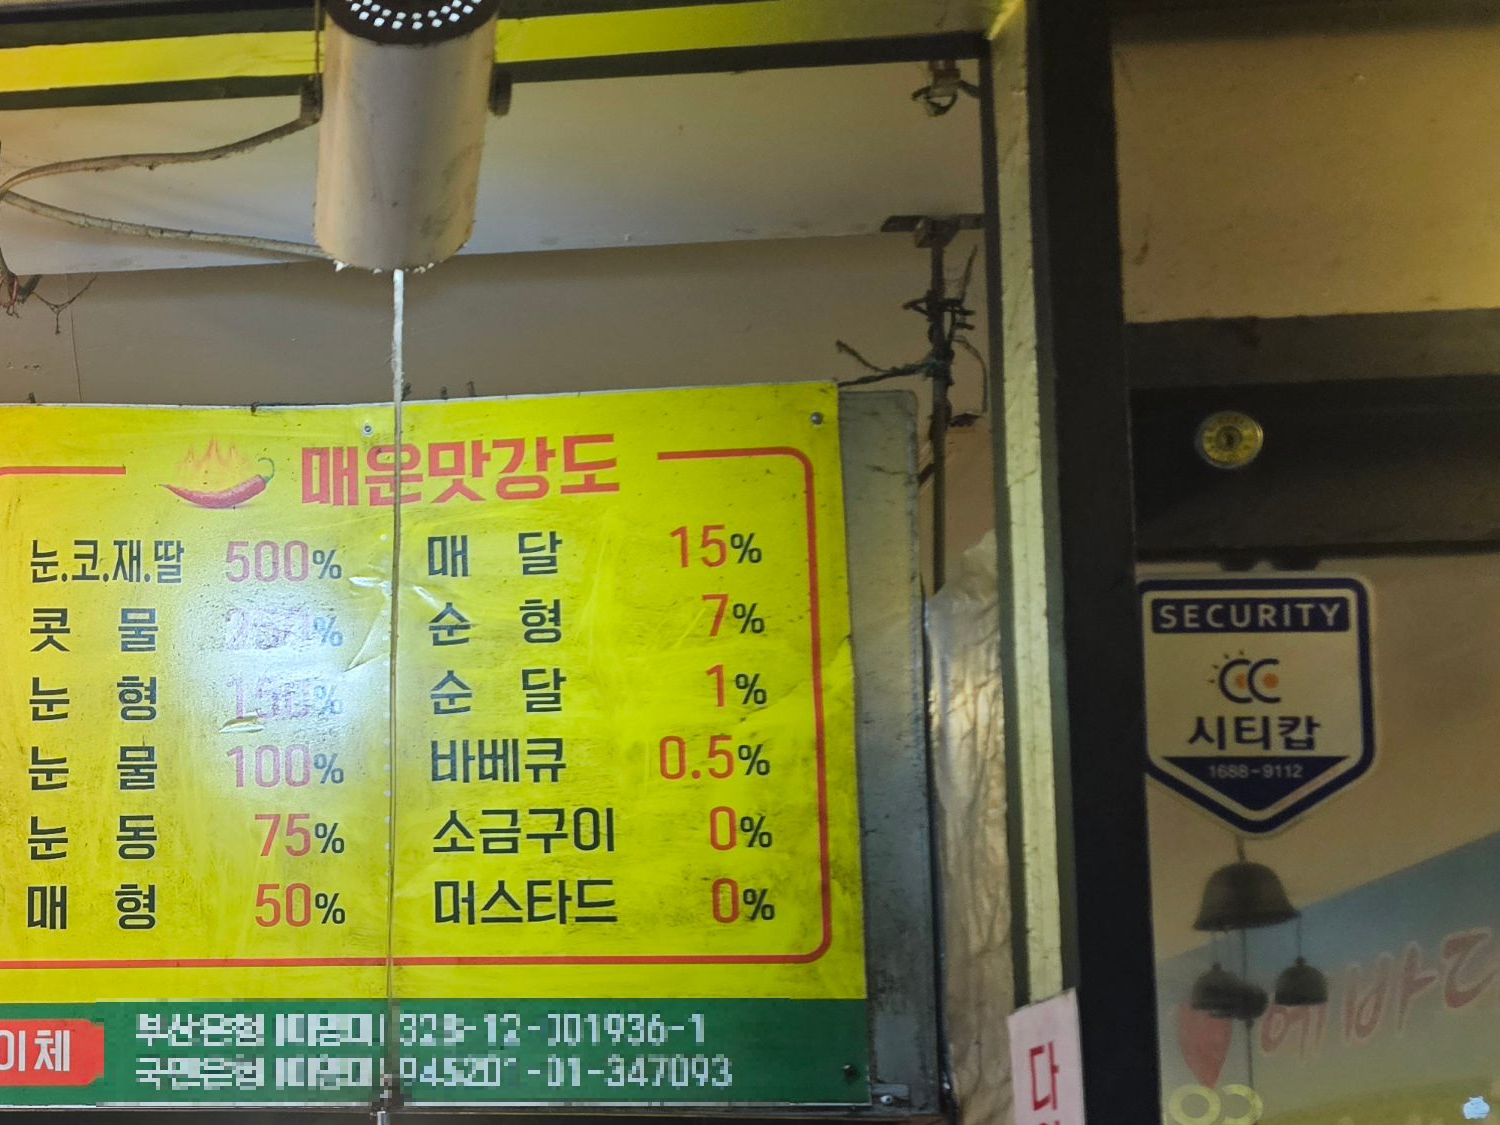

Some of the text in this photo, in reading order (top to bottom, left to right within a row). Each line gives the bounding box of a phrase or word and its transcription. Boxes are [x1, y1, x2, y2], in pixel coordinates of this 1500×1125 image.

[300, 434, 620, 507] 매운맛강도
[30, 538, 342, 584] 눈.코.재.딸 500%
[670, 524, 763, 568] 15%
[701, 594, 766, 637] 7%
[1159, 603, 1340, 629] SECURITY
[705, 664, 767, 708] 1%
[1187, 715, 1321, 751] 시티캅
[226, 744, 344, 788] 100%
[431, 733, 771, 783] 바베큐 0.5%
[254, 813, 345, 857] 75%
[433, 806, 773, 854] 소금구이 0%
[255, 883, 346, 927] 50%
[434, 878, 775, 926] 머스타드 0%
